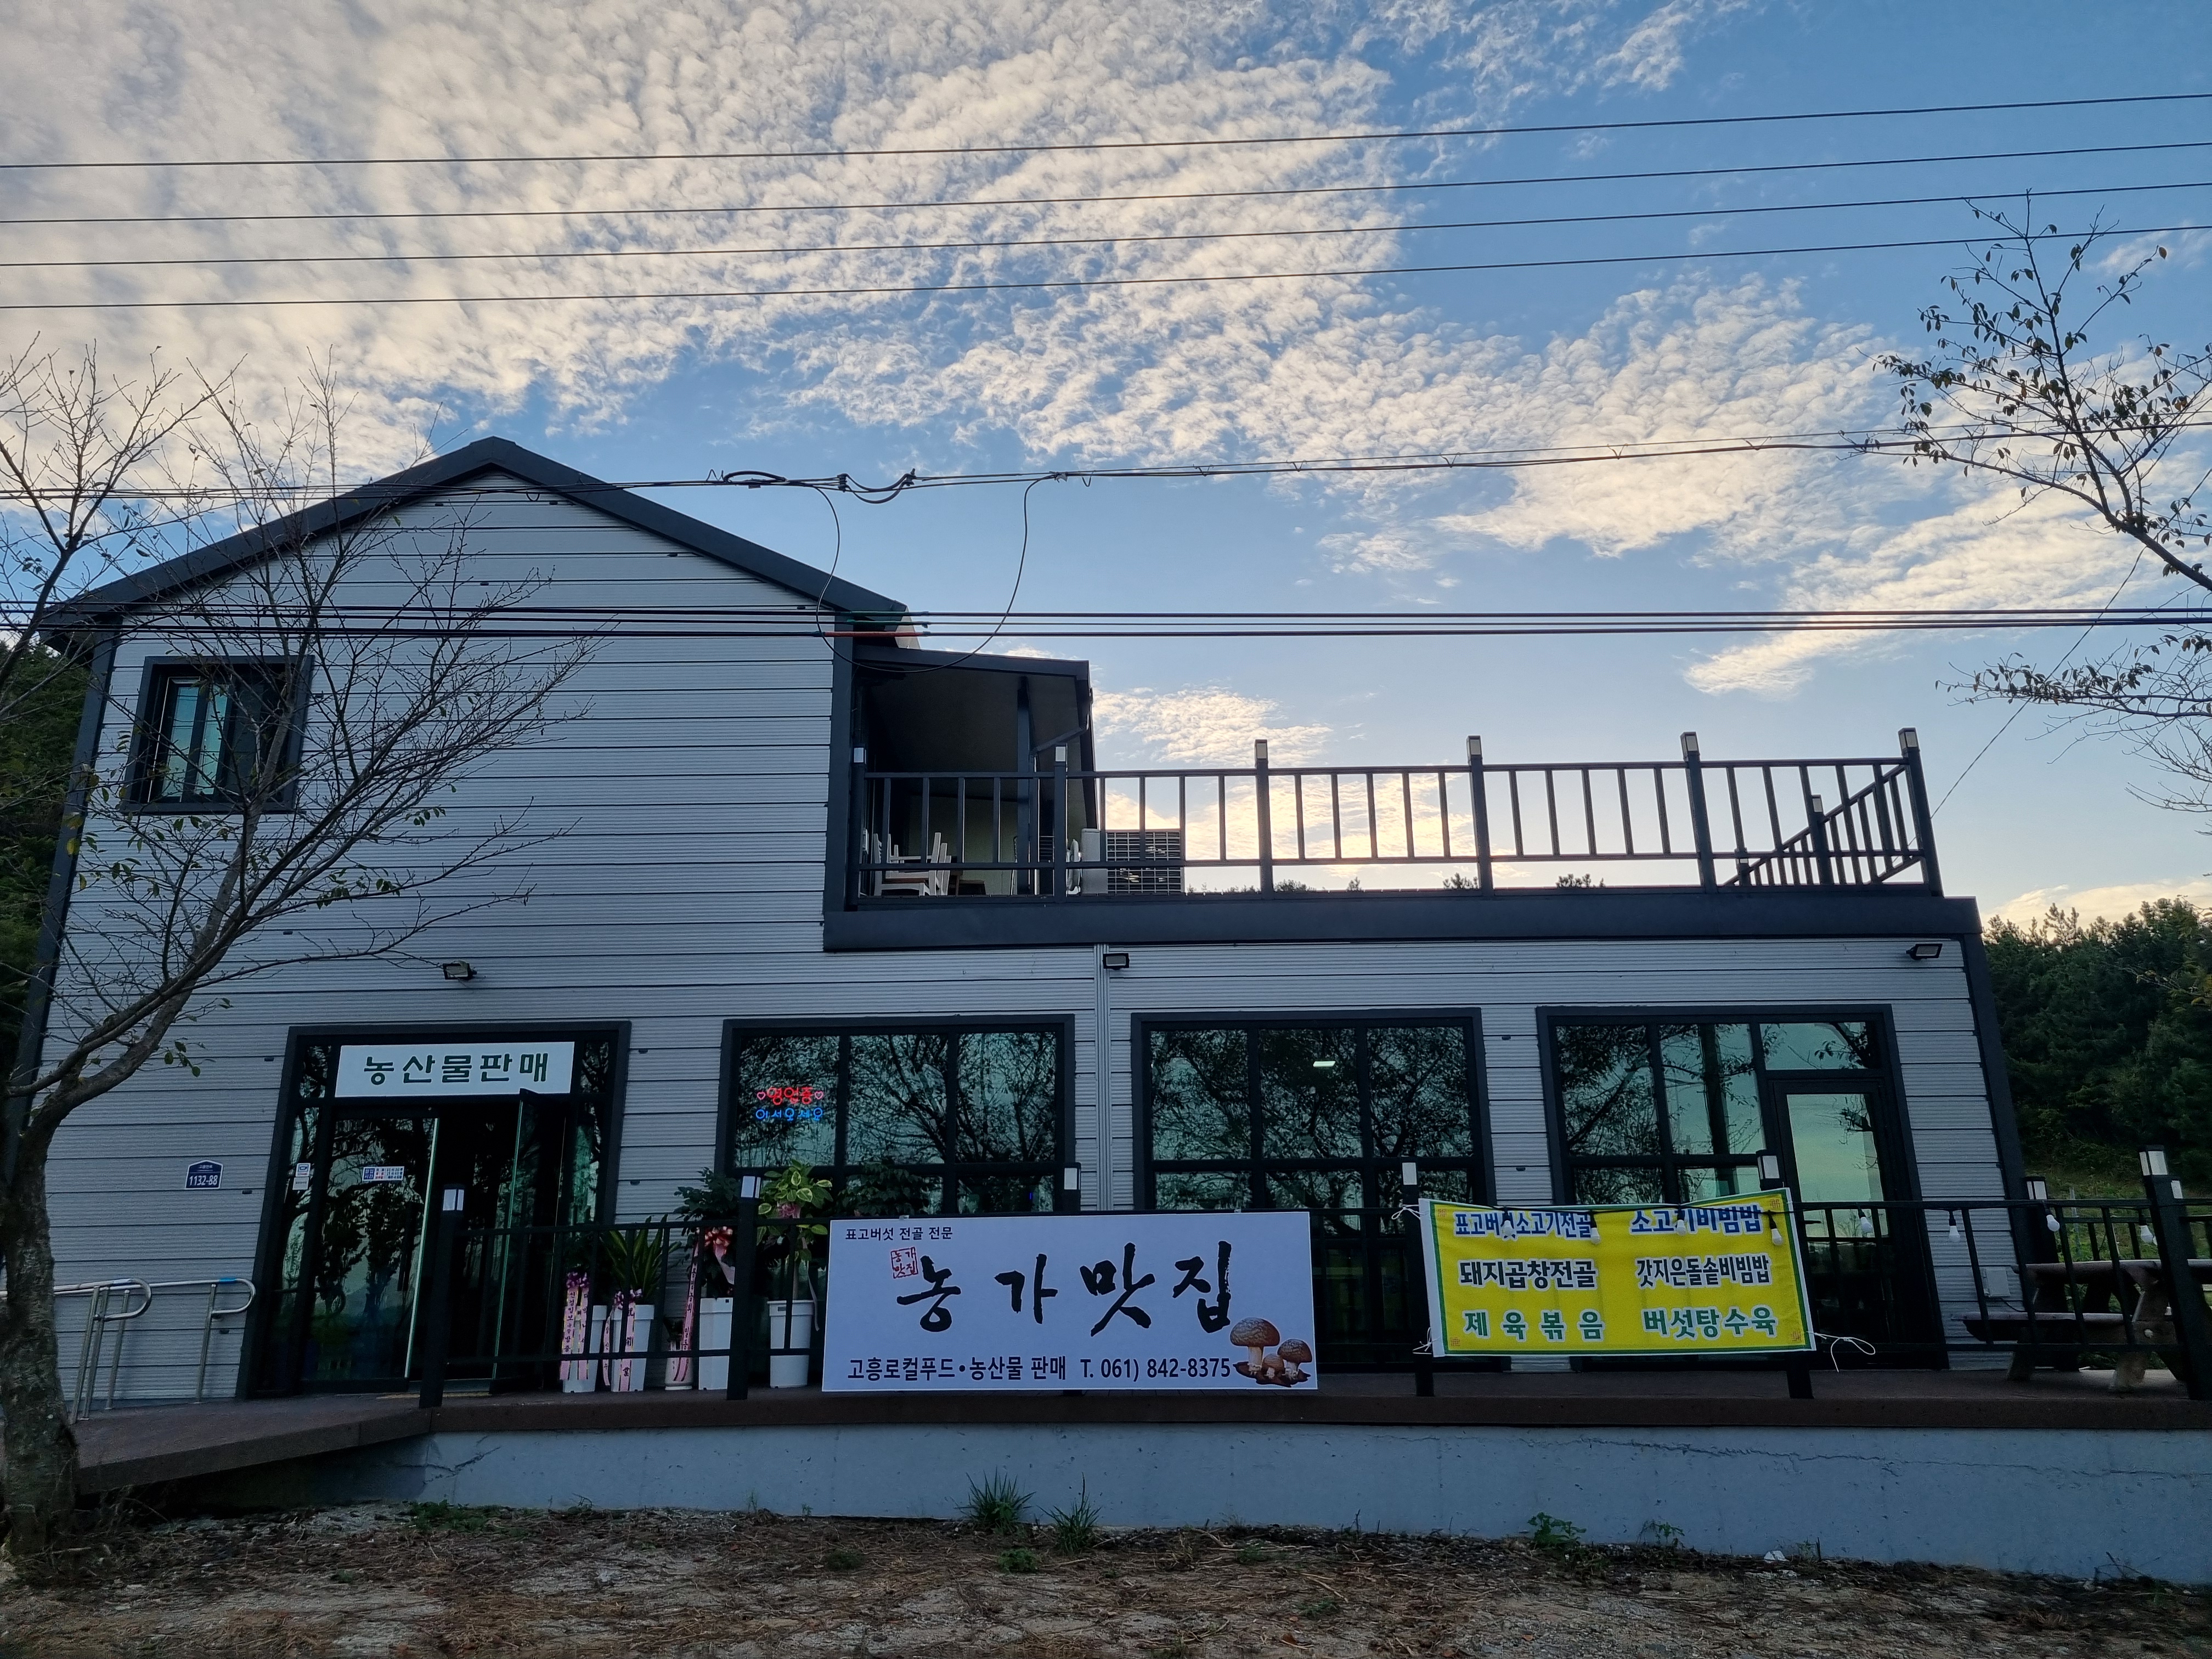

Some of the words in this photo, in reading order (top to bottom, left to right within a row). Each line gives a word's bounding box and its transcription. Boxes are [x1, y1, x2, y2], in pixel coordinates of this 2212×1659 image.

[364, 1053, 549, 1085] 농산물판매
[767, 1086, 813, 1105] 영업중
[755, 1107, 823, 1121] 어서오세요
[189, 1175, 218, 1186] 1132-88
[845, 1227, 894, 1241] 표고버섯
[900, 1227, 923, 1240] 전골
[929, 1227, 953, 1240] 전문
[1460, 1261, 1596, 1289] 돼지곱창전골
[1637, 1255, 1769, 1286] 갓지은돌솥비빔밥
[1464, 1312, 1602, 1340] 제육볶음
[1644, 1307, 1776, 1338] 버섯탕수육
[1031, 1356, 1066, 1380] 판매
[1080, 1359, 1094, 1378] T.
[1101, 1358, 1139, 1382] 061)
[1147, 1358, 1231, 1378] 842-8375
